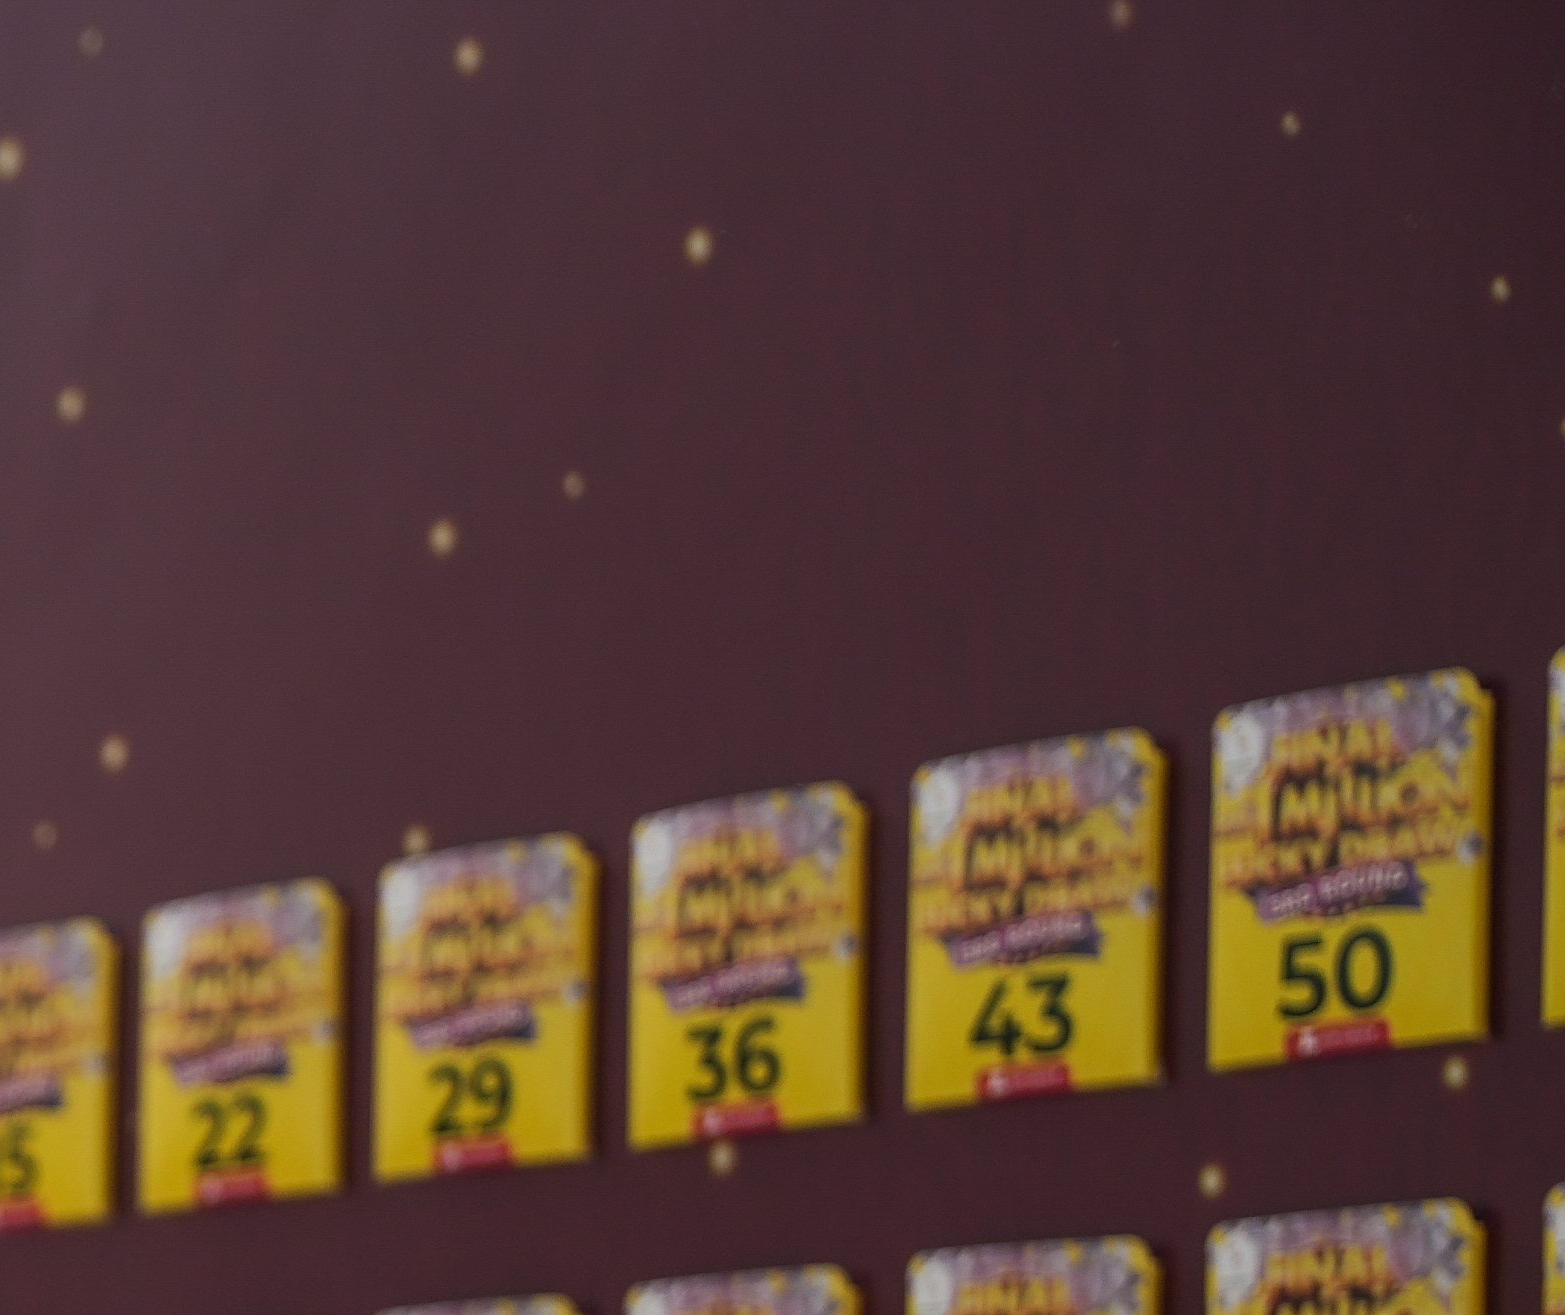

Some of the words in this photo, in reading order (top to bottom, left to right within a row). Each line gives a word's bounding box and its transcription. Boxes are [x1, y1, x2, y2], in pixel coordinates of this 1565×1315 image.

[1281, 925, 1392, 1019] 50
[969, 976, 1075, 1058] 43
[429, 1059, 513, 1137] 29
[688, 1018, 782, 1101] 36
[193, 1095, 267, 1169] 22
